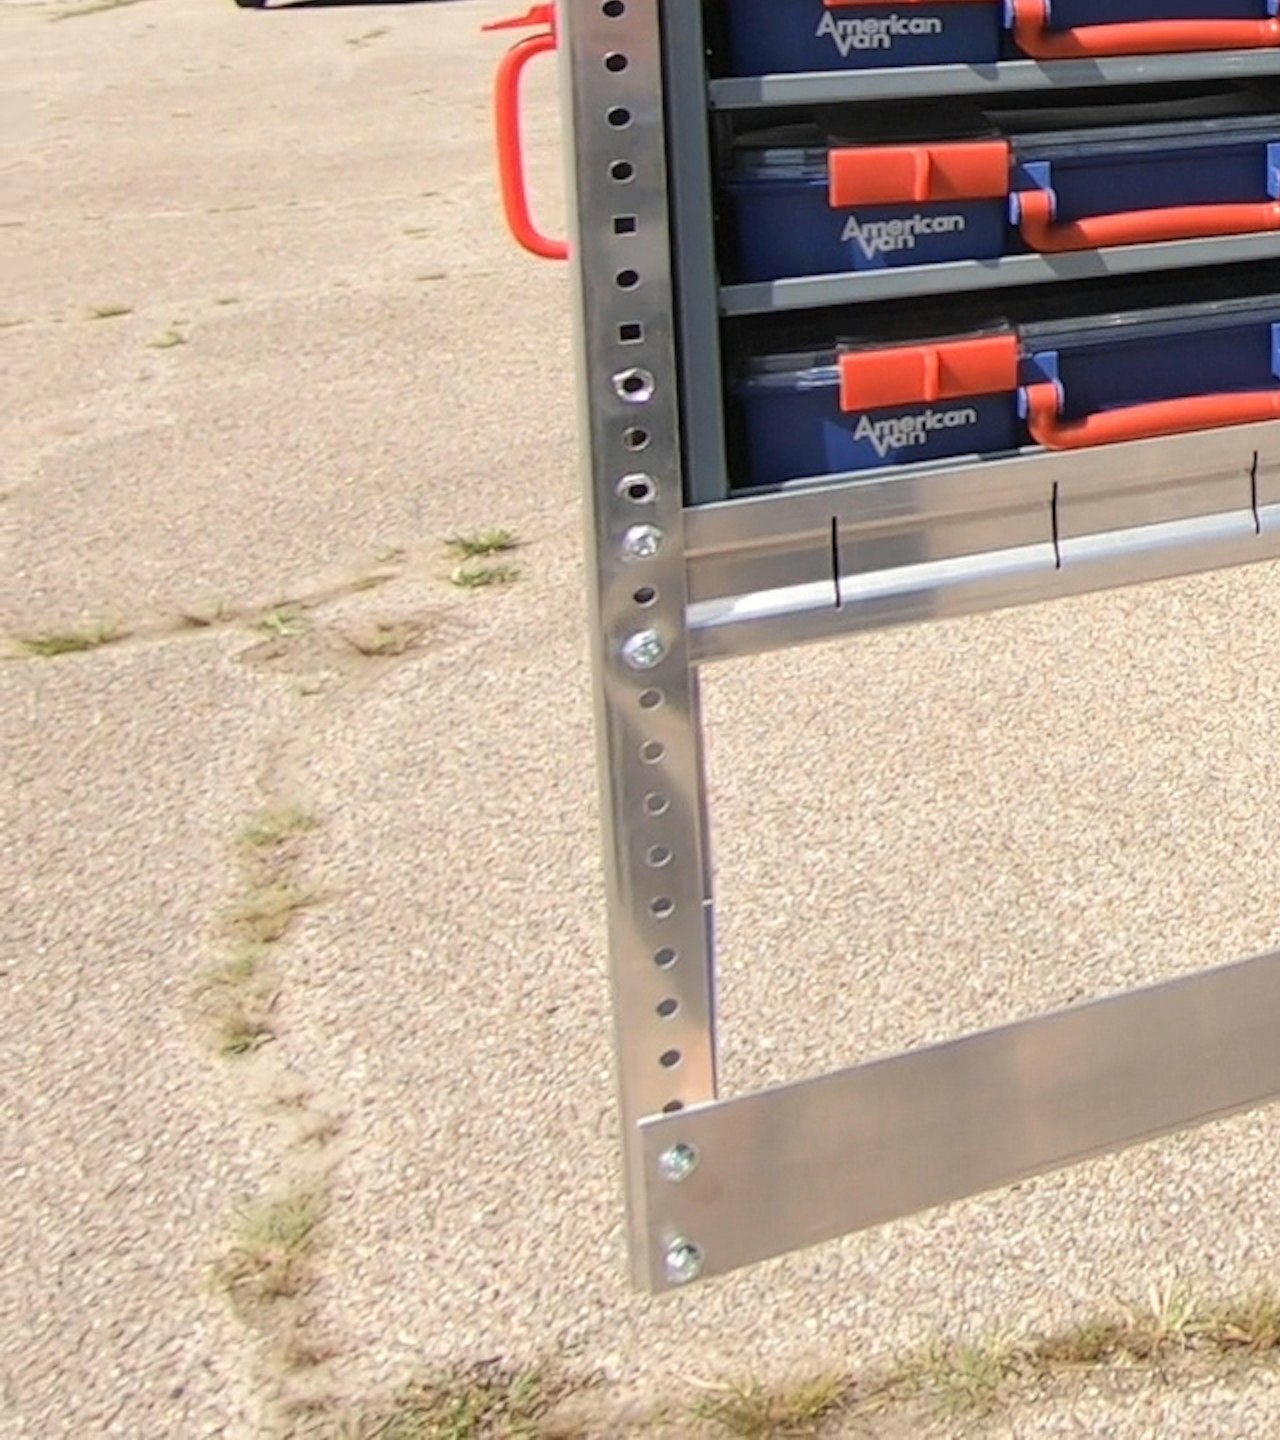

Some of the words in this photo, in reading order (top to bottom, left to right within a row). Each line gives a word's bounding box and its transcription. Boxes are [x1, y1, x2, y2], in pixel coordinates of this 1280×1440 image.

[815, 9, 942, 37] American
[841, 214, 965, 241] American
[853, 408, 977, 441] American
